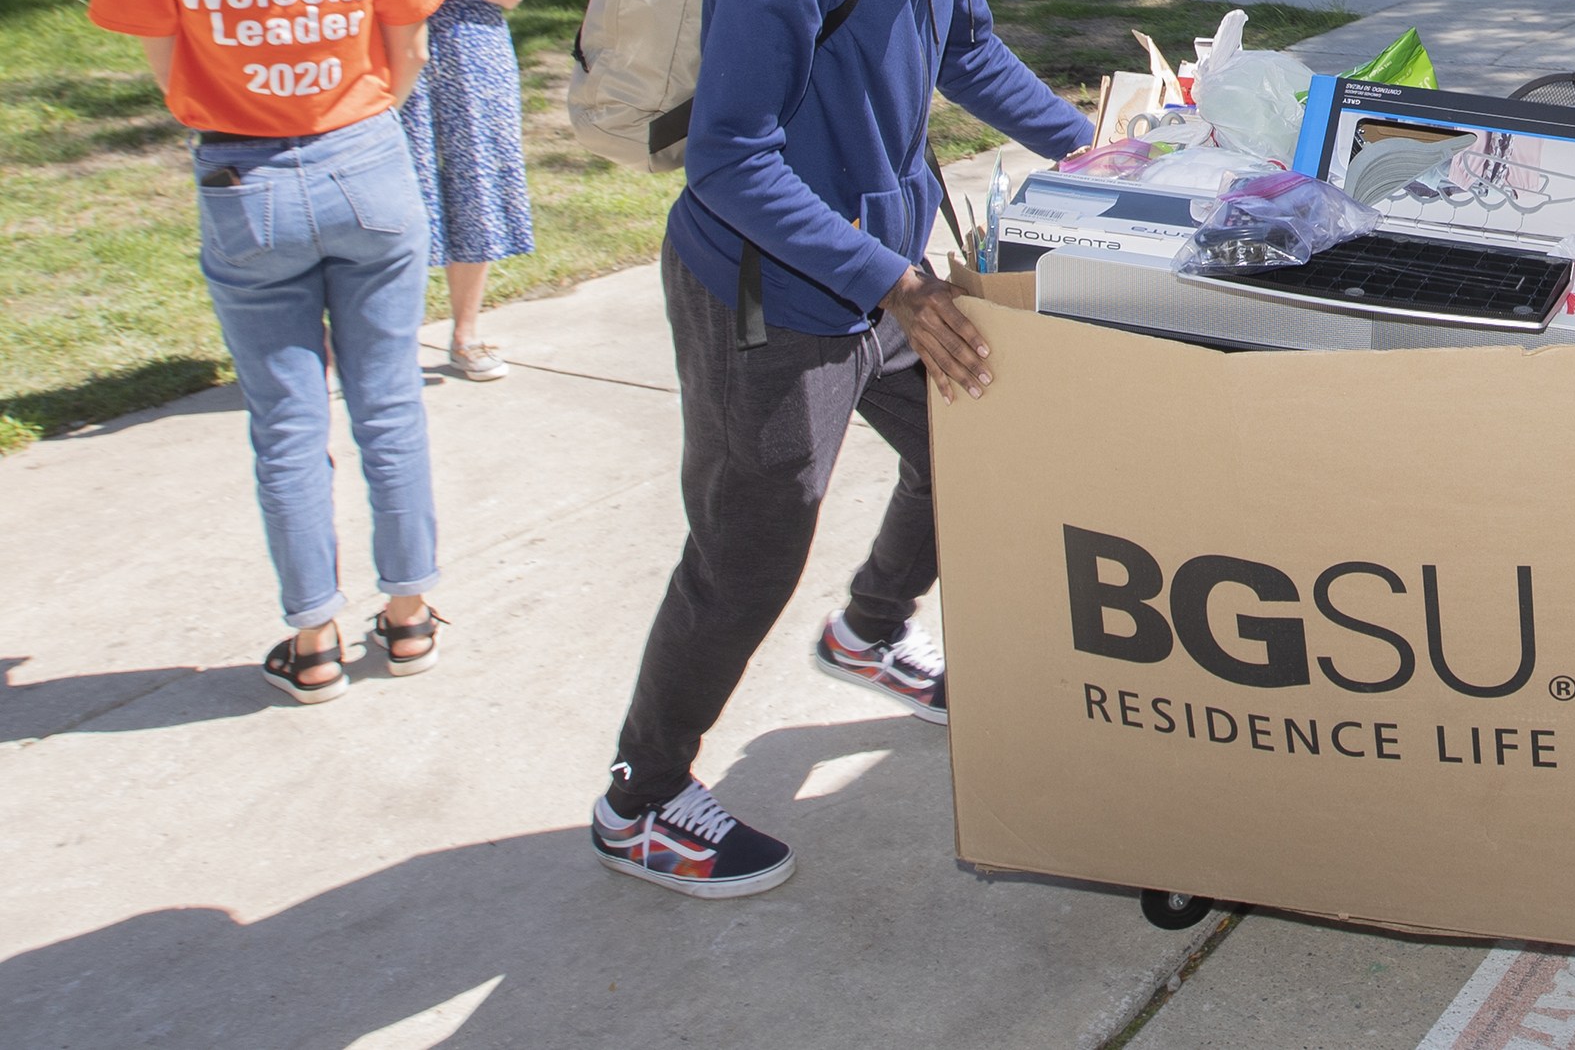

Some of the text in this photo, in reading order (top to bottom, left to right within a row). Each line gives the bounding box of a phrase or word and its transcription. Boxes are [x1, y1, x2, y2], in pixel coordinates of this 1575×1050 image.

[210, 5, 366, 47] Leader
[243, 57, 343, 97] 2020
[1345, 83, 1363, 91] PIEZAS
[1084, 683, 1558, 769] RESIDENCE LIFE
